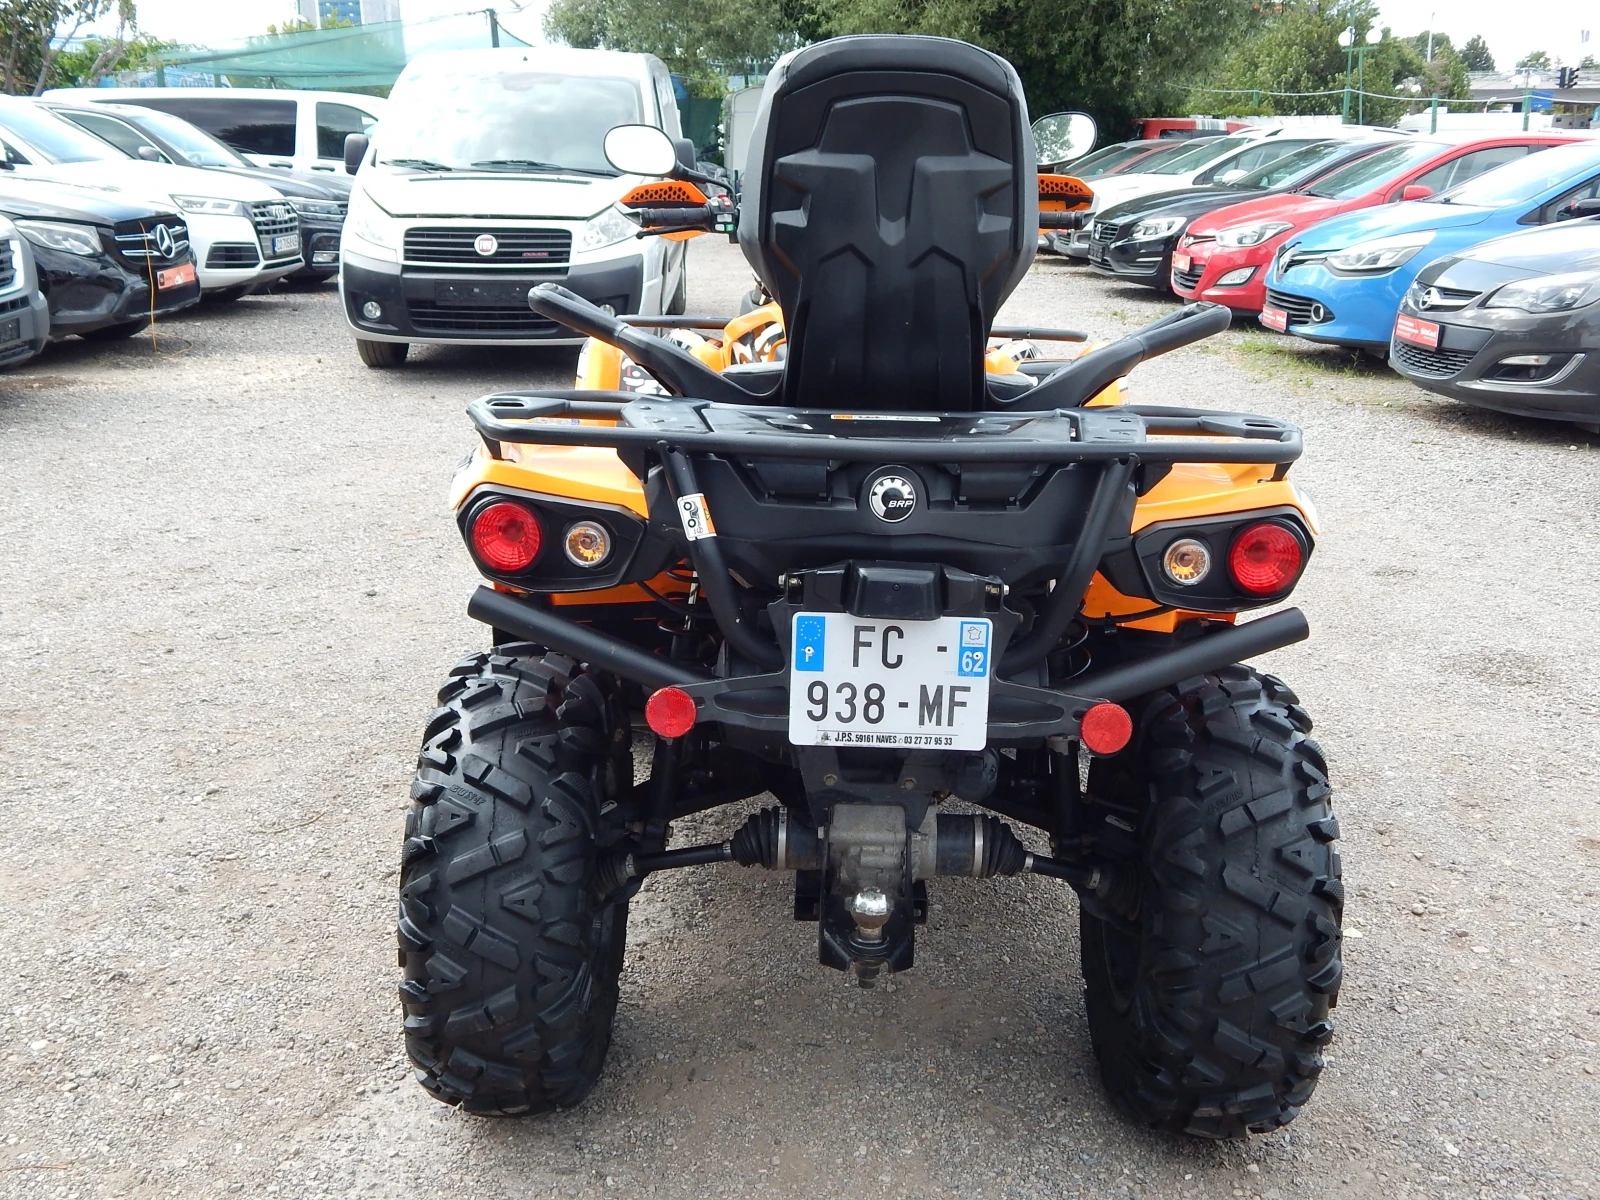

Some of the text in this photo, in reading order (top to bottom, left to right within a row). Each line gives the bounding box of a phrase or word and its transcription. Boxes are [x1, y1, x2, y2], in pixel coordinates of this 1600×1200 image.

[888, 500, 913, 508] BRP
[852, 625, 905, 670] FC
[961, 651, 985, 673] 62
[806, 680, 886, 725] 938
[834, 732, 953, 746] J.P.S. 59161 NAVES 03 27 37 95 33
